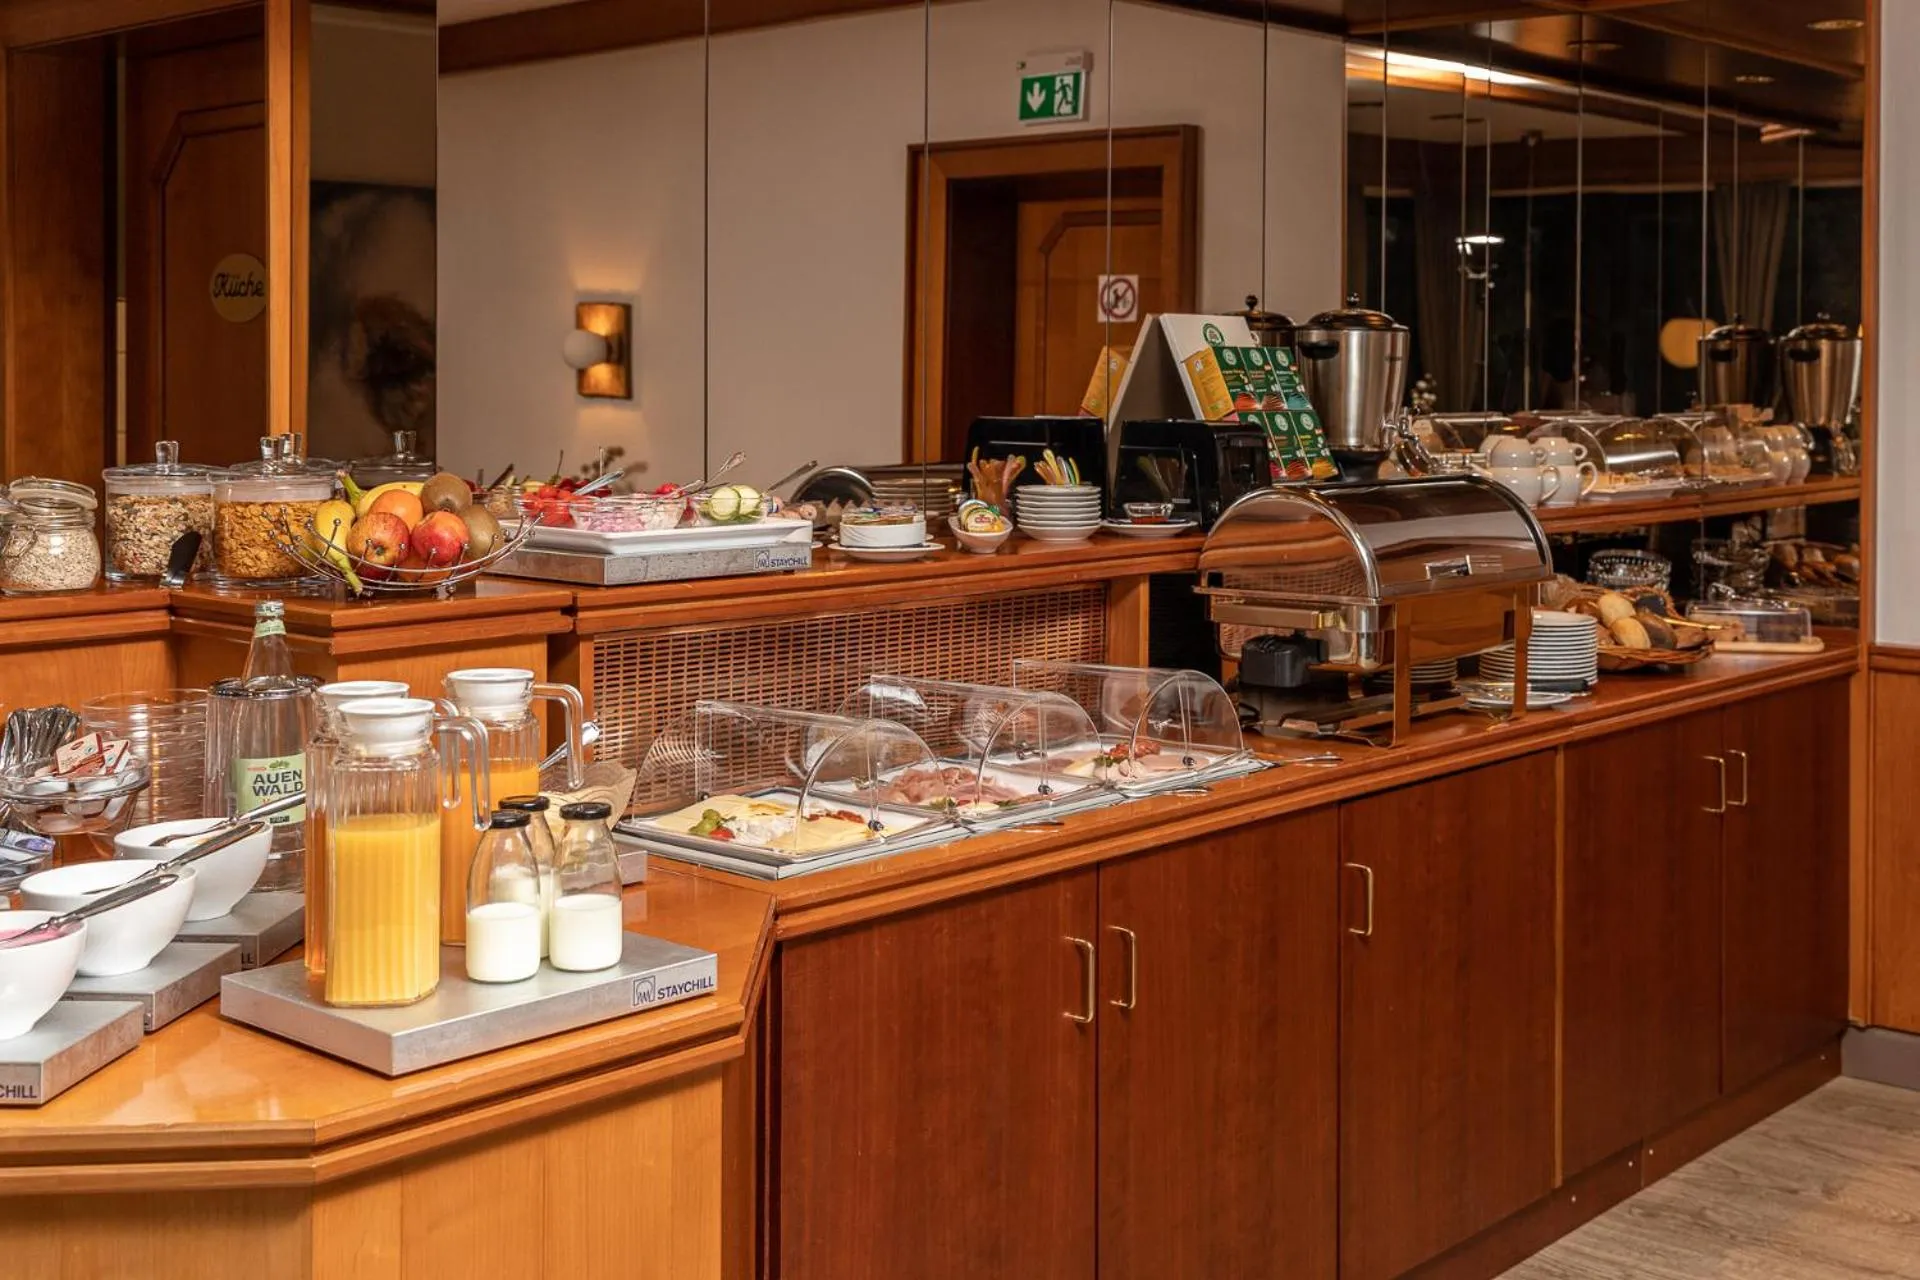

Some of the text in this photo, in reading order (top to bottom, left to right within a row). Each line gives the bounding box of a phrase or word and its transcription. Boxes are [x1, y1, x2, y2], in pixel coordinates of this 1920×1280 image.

[770, 556, 808, 568] STAYCHILL
[253, 769, 303, 785] AUEN
[252, 781, 304, 797] WALD
[657, 975, 714, 1000] STAYCHILL
